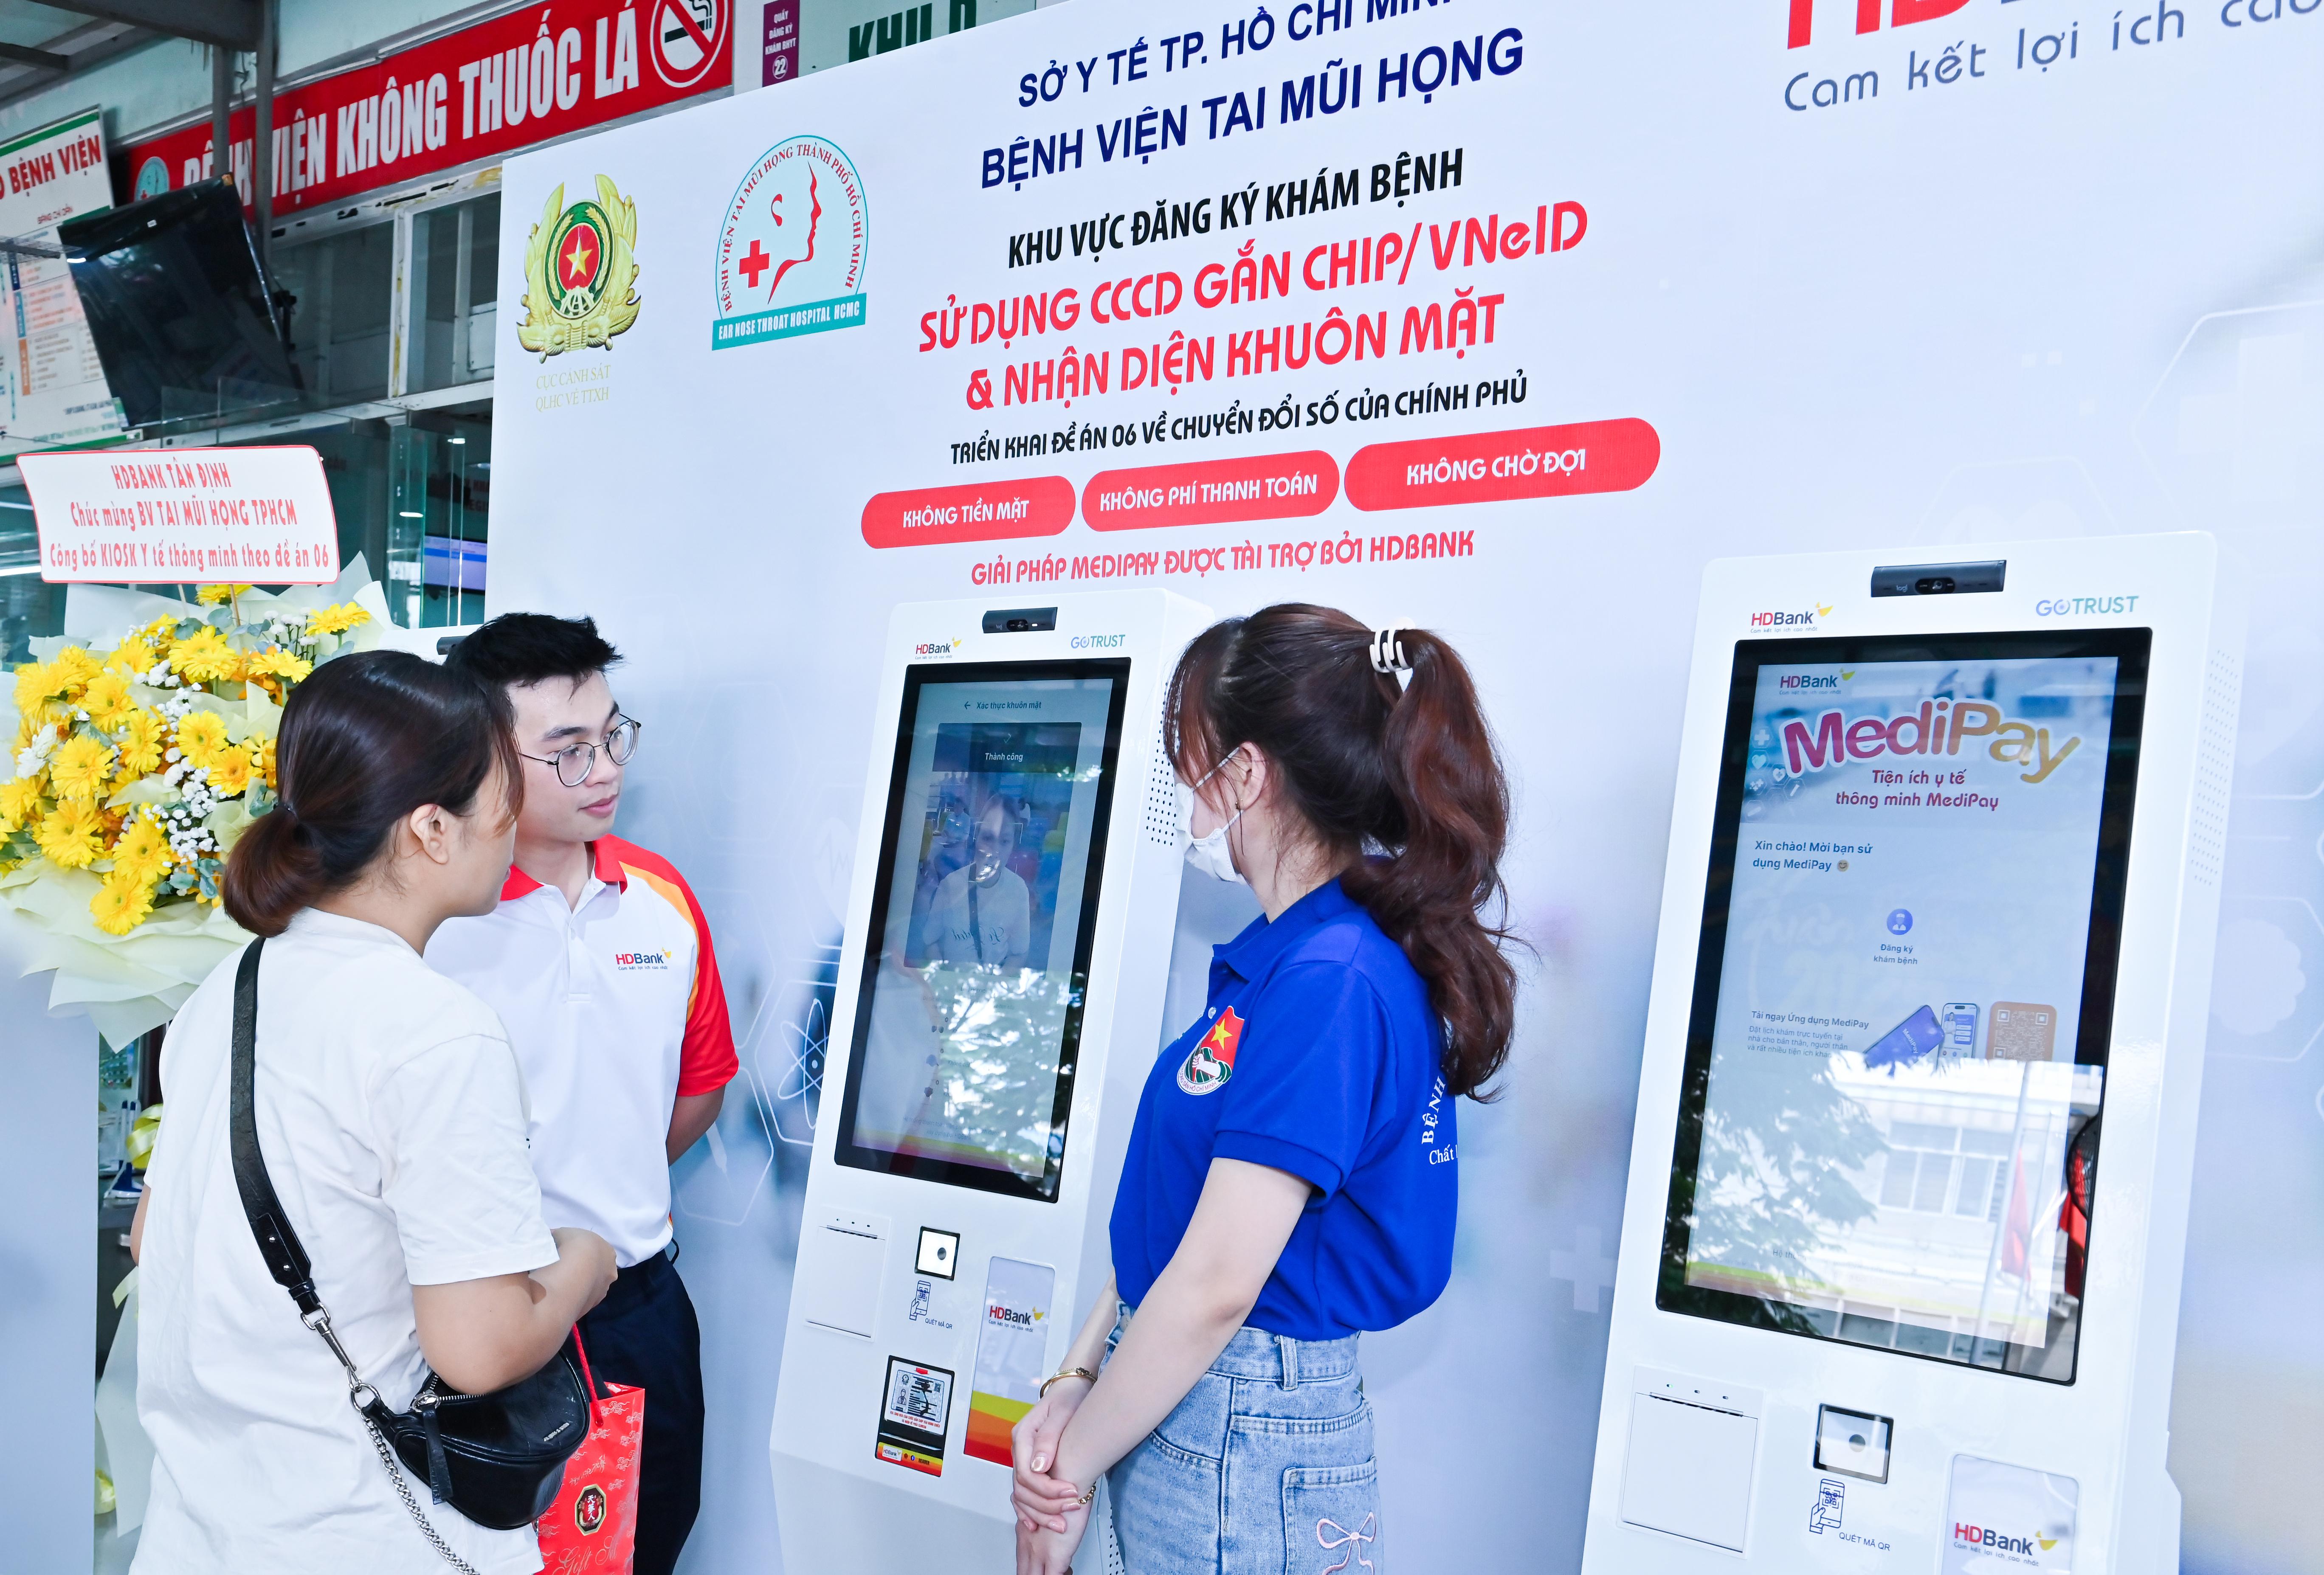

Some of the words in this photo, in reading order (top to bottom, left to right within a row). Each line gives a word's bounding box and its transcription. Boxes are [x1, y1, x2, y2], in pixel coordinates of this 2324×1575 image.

[775, 58, 786, 76] 22
[1019, 60, 1068, 107] SỞ
[1076, 57, 1098, 93] Y
[1107, 37, 1148, 85] TẾ
[1161, 32, 1207, 72] TP.
[1222, 6, 1274, 59] HỒ
[1785, 71, 1878, 111] Cam
[1908, 41, 1986, 90] kết
[2017, 22, 2078, 72] lợi
[2113, 0, 2183, 50] ích
[337, 73, 447, 177] KHÔNG
[459, 9, 581, 139] THUỐC
[594, 0, 639, 99] LÁ
[982, 129, 1083, 191] BỆNH
[1096, 105, 1187, 164] VIỆN
[1202, 87, 1265, 139] TAI
[1281, 58, 1361, 124] MŨI
[1378, 28, 1522, 104] HỌNG
[764, 147, 793, 173] HỌNG
[797, 142, 831, 159] THÀNH
[8, 153, 55, 196] BỆNH
[57, 135, 101, 175] VIỆN
[831, 158, 853, 184] PHỐ
[744, 169, 763, 197] MŨI
[846, 183, 861, 206] HỒ
[731, 197, 745, 221] TAI
[1009, 227, 1062, 268] KHU
[1070, 213, 1125, 262] VỰC
[1131, 199, 1210, 245] ĐĂNG
[1221, 182, 1259, 230] KÝ
[1266, 167, 1358, 221] KHÁM
[1371, 148, 1462, 207] BỆNH
[852, 210, 863, 239] CHÍ
[722, 226, 734, 264] VIỆN
[845, 244, 860, 288] MINH
[721, 270, 732, 312] BỆNH
[920, 294, 967, 352] SỬ
[971, 288, 1080, 349] DỤNG
[1091, 272, 1182, 323] CCCD
[1194, 239, 1290, 308] GẮN
[718, 321, 733, 340] EAR
[735, 320, 755, 337] NOSE
[758, 314, 789, 332] THROAT
[790, 307, 830, 327] HOSPITAL
[834, 301, 859, 319] HCMC
[966, 369, 994, 410] &
[1004, 346, 1109, 408] NHẬN
[1121, 330, 1214, 395] DIỆN
[1227, 307, 1386, 377] KHUÔN
[1400, 286, 1504, 359] MẶT
[591, 363, 611, 380] SÁT
[536, 394, 563, 412] QLHC
[581, 387, 609, 403] TTXH
[951, 430, 999, 464] TRIỂN
[1005, 434, 1046, 458] KHAI
[1052, 422, 1076, 453] ĐỀ
[1080, 423, 1107, 450] ÁN
[1113, 424, 1136, 447] 06
[1142, 411, 1167, 444] VỀ
[1172, 400, 1253, 440] CHUYỂN
[1259, 394, 1300, 431] ĐỔI
[1307, 390, 1339, 426] SỐ
[1346, 388, 1389, 421] CỦA
[1395, 382, 1468, 415] CHÍNH
[1476, 369, 1527, 407] PHỦ
[111, 464, 166, 489] HDBANK
[166, 457, 195, 488] TÂN
[197, 463, 231, 492] ĐỊNH
[1407, 457, 1486, 485] KHÔNG
[1492, 449, 1541, 477] CHỜ
[1543, 449, 1585, 476] ĐỢI
[1100, 487, 1163, 511] KHÔNG
[1169, 481, 1197, 505] PHÍ
[1201, 480, 1260, 503] THANH
[1265, 471, 1317, 497] TOÁN
[71, 502, 99, 526] Chúc
[137, 501, 153, 526] BV
[156, 501, 180, 526] TAI
[183, 495, 206, 526] MŨI
[209, 500, 249, 530] HỌNG
[251, 499, 297, 525] TPHCM
[903, 505, 958, 527] KHÔNG
[961, 498, 992, 522] TIỀN
[997, 497, 1029, 522] MẶT
[51, 543, 77, 571] Công
[82, 540, 96, 566] bố
[101, 543, 137, 567] KIOSK
[141, 543, 146, 566] Y
[153, 540, 164, 566] tế
[169, 543, 203, 572] thông
[208, 543, 237, 566] minh
[242, 543, 270, 567] theo
[276, 539, 290, 567] đề
[296, 543, 309, 567] án
[314, 544, 328, 567] 06
[972, 555, 1011, 585] GIẢI
[1017, 554, 1066, 582] PHÁP
[1071, 552, 1158, 579] MEDIPAY
[1164, 548, 1225, 577] ĐƯỢC
[1231, 540, 1262, 570] TÀI
[1268, 541, 1317, 572] TRỢ
[1321, 531, 1362, 565] BỞI
[1370, 530, 1474, 562] HDBANK
[1752, 611, 1813, 625] HDBank
[916, 643, 950, 654] HDBank
[1780, 675, 1838, 688] HDBank
[1784, 700, 2080, 784] MediPay
[985, 752, 1005, 760] Thành
[1007, 753, 1023, 762] công
[1873, 770, 1903, 786] Tiện
[1909, 770, 1929, 784] ích
[1935, 775, 1944, 788] y
[1950, 769, 1966, 784] tế
[1837, 791, 1878, 808] thông
[1885, 792, 1920, 806] minh
[1927, 793, 1998, 811] MediPay
[1755, 841, 1772, 849] Xin
[1776, 841, 1806, 851] chào!
[1810, 842, 1830, 852] Mời
[1834, 844, 1854, 855] bạn
[1858, 844, 1873, 853] sử
[1753, 858, 1780, 870] dụng
[1784, 859, 1831, 872] MediPay
[616, 953, 664, 965] HDBank
[1881, 944, 1901, 953] Đăng
[1832, 1018, 1869, 1029] MediPay
[1422, 1077, 1445, 1144] BỆNH
[1429, 1144, 1454, 1164] Chất
[990, 1306, 1031, 1325] HDBank
[1839, 1533, 1862, 1543] QUÉT
[1864, 1538, 1875, 1547] MÃ
[1878, 1542, 1890, 1551] QR
[1954, 1523, 2033, 1555] HDBank
